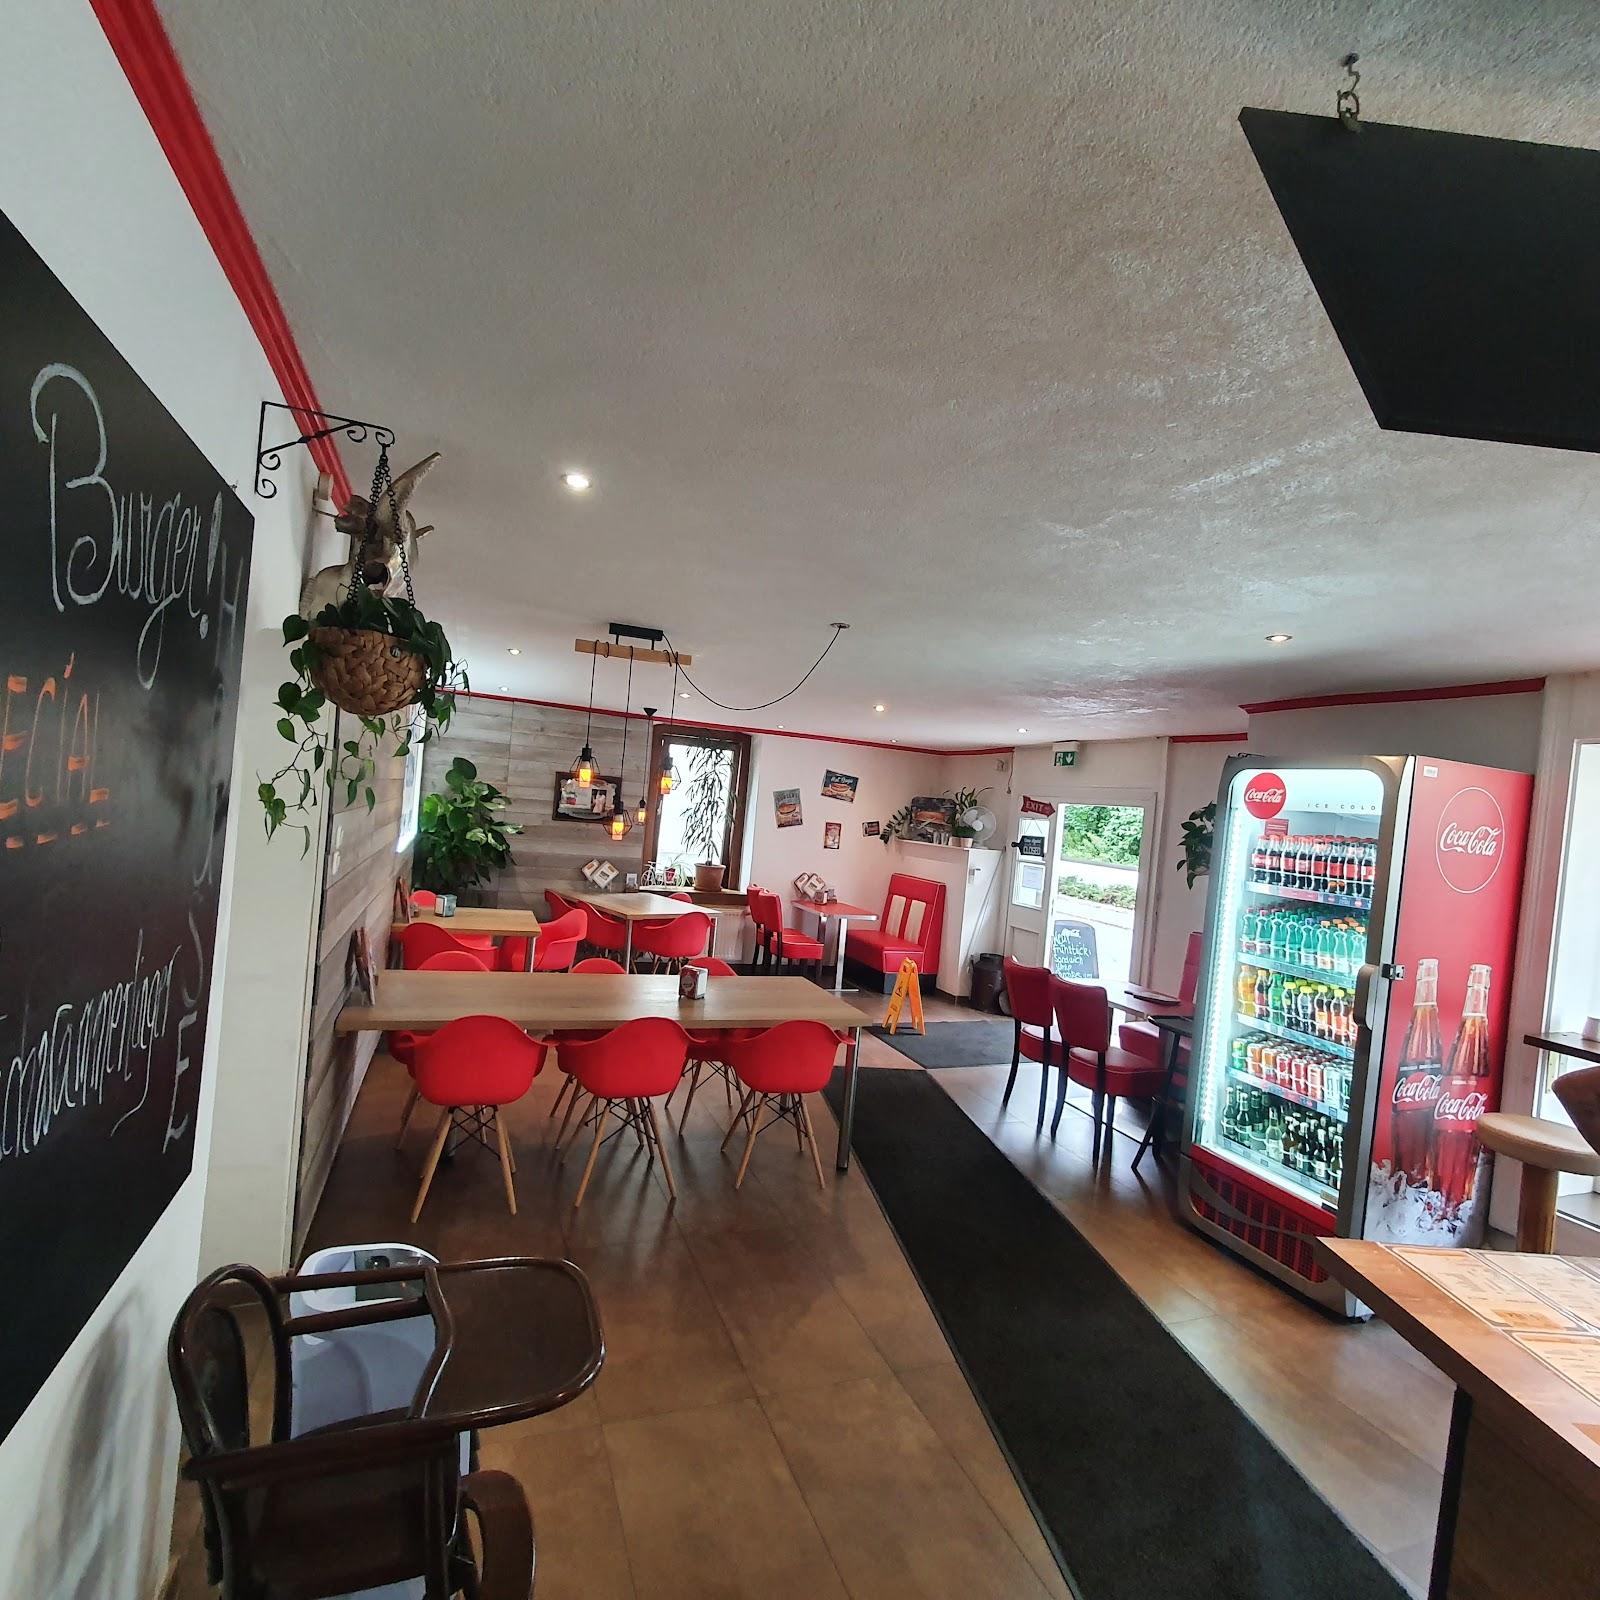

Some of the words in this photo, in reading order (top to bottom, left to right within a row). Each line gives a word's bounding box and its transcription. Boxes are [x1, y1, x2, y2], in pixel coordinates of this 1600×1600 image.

[29, 362, 223, 691] Burger!
[1026, 801, 1045, 812] EXIT
[1245, 787, 1285, 803] Coca-Cola
[1439, 822, 1502, 857] Coca-Cola
[1392, 1073, 1443, 1104] Coca-Cola
